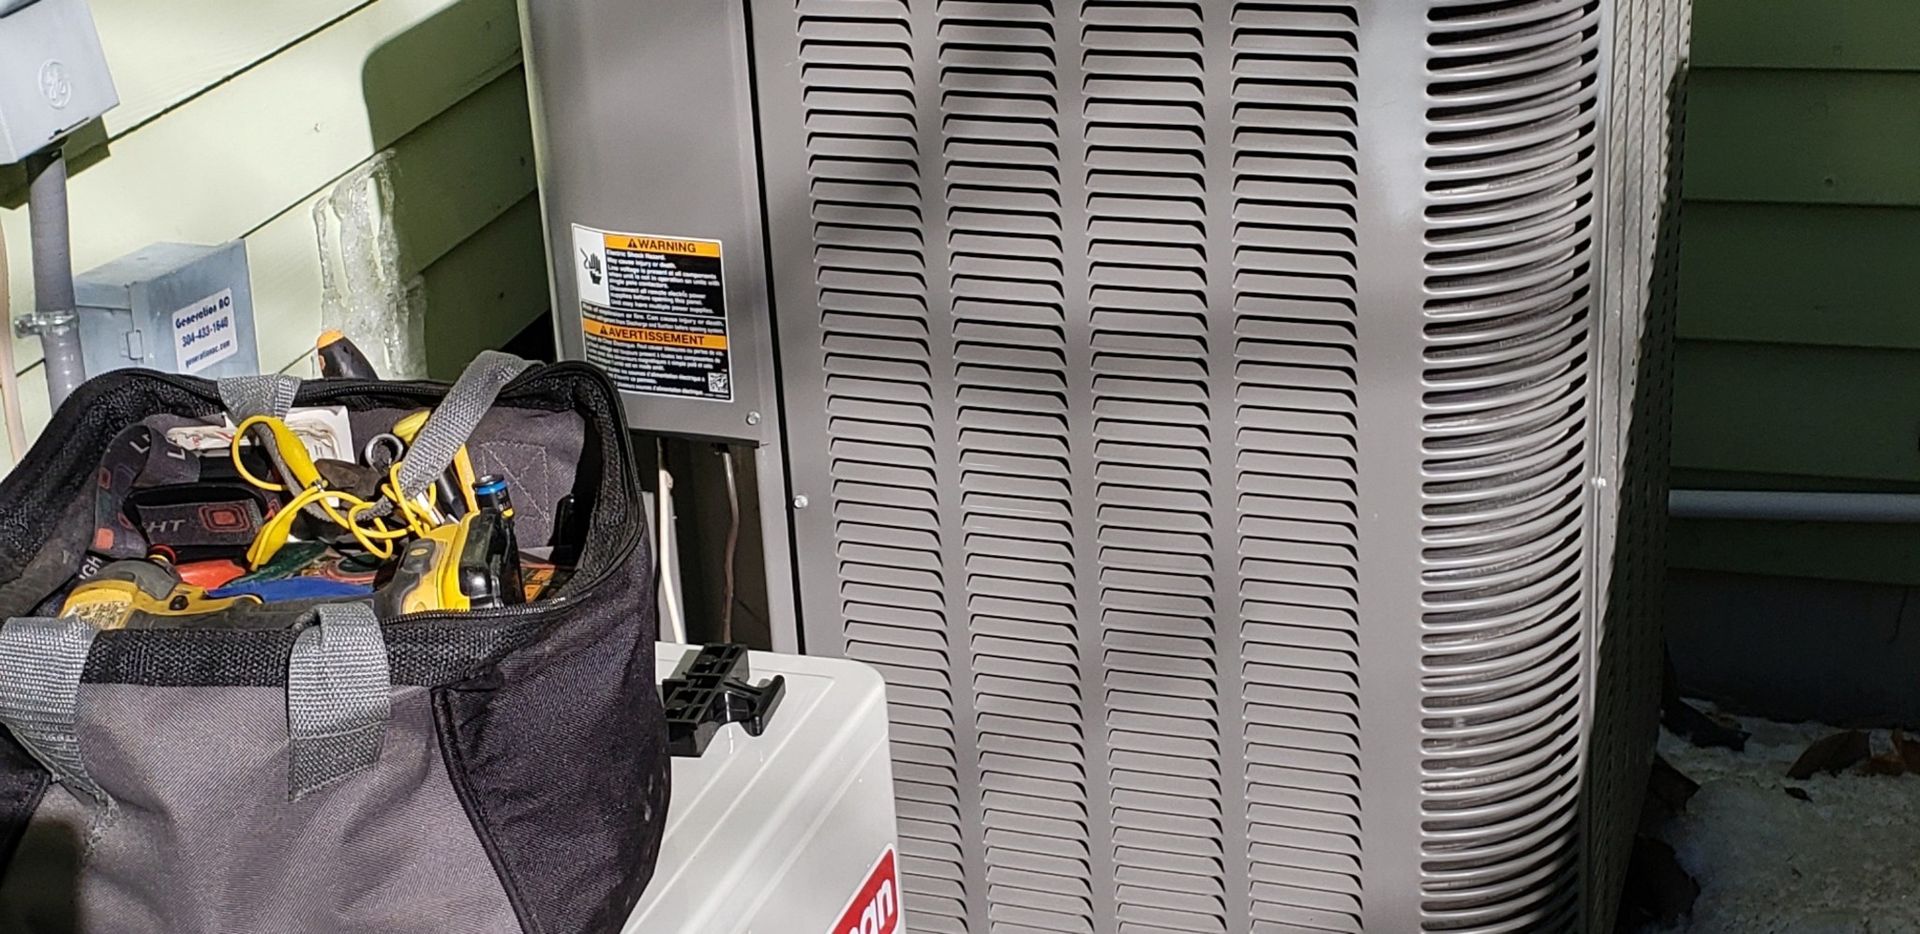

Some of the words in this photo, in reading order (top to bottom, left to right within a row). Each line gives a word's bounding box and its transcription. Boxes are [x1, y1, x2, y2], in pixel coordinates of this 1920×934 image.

[638, 238, 697, 253] WARNING
[176, 304, 217, 329] Generation
[609, 327, 705, 346] AVERTISSEMENT
